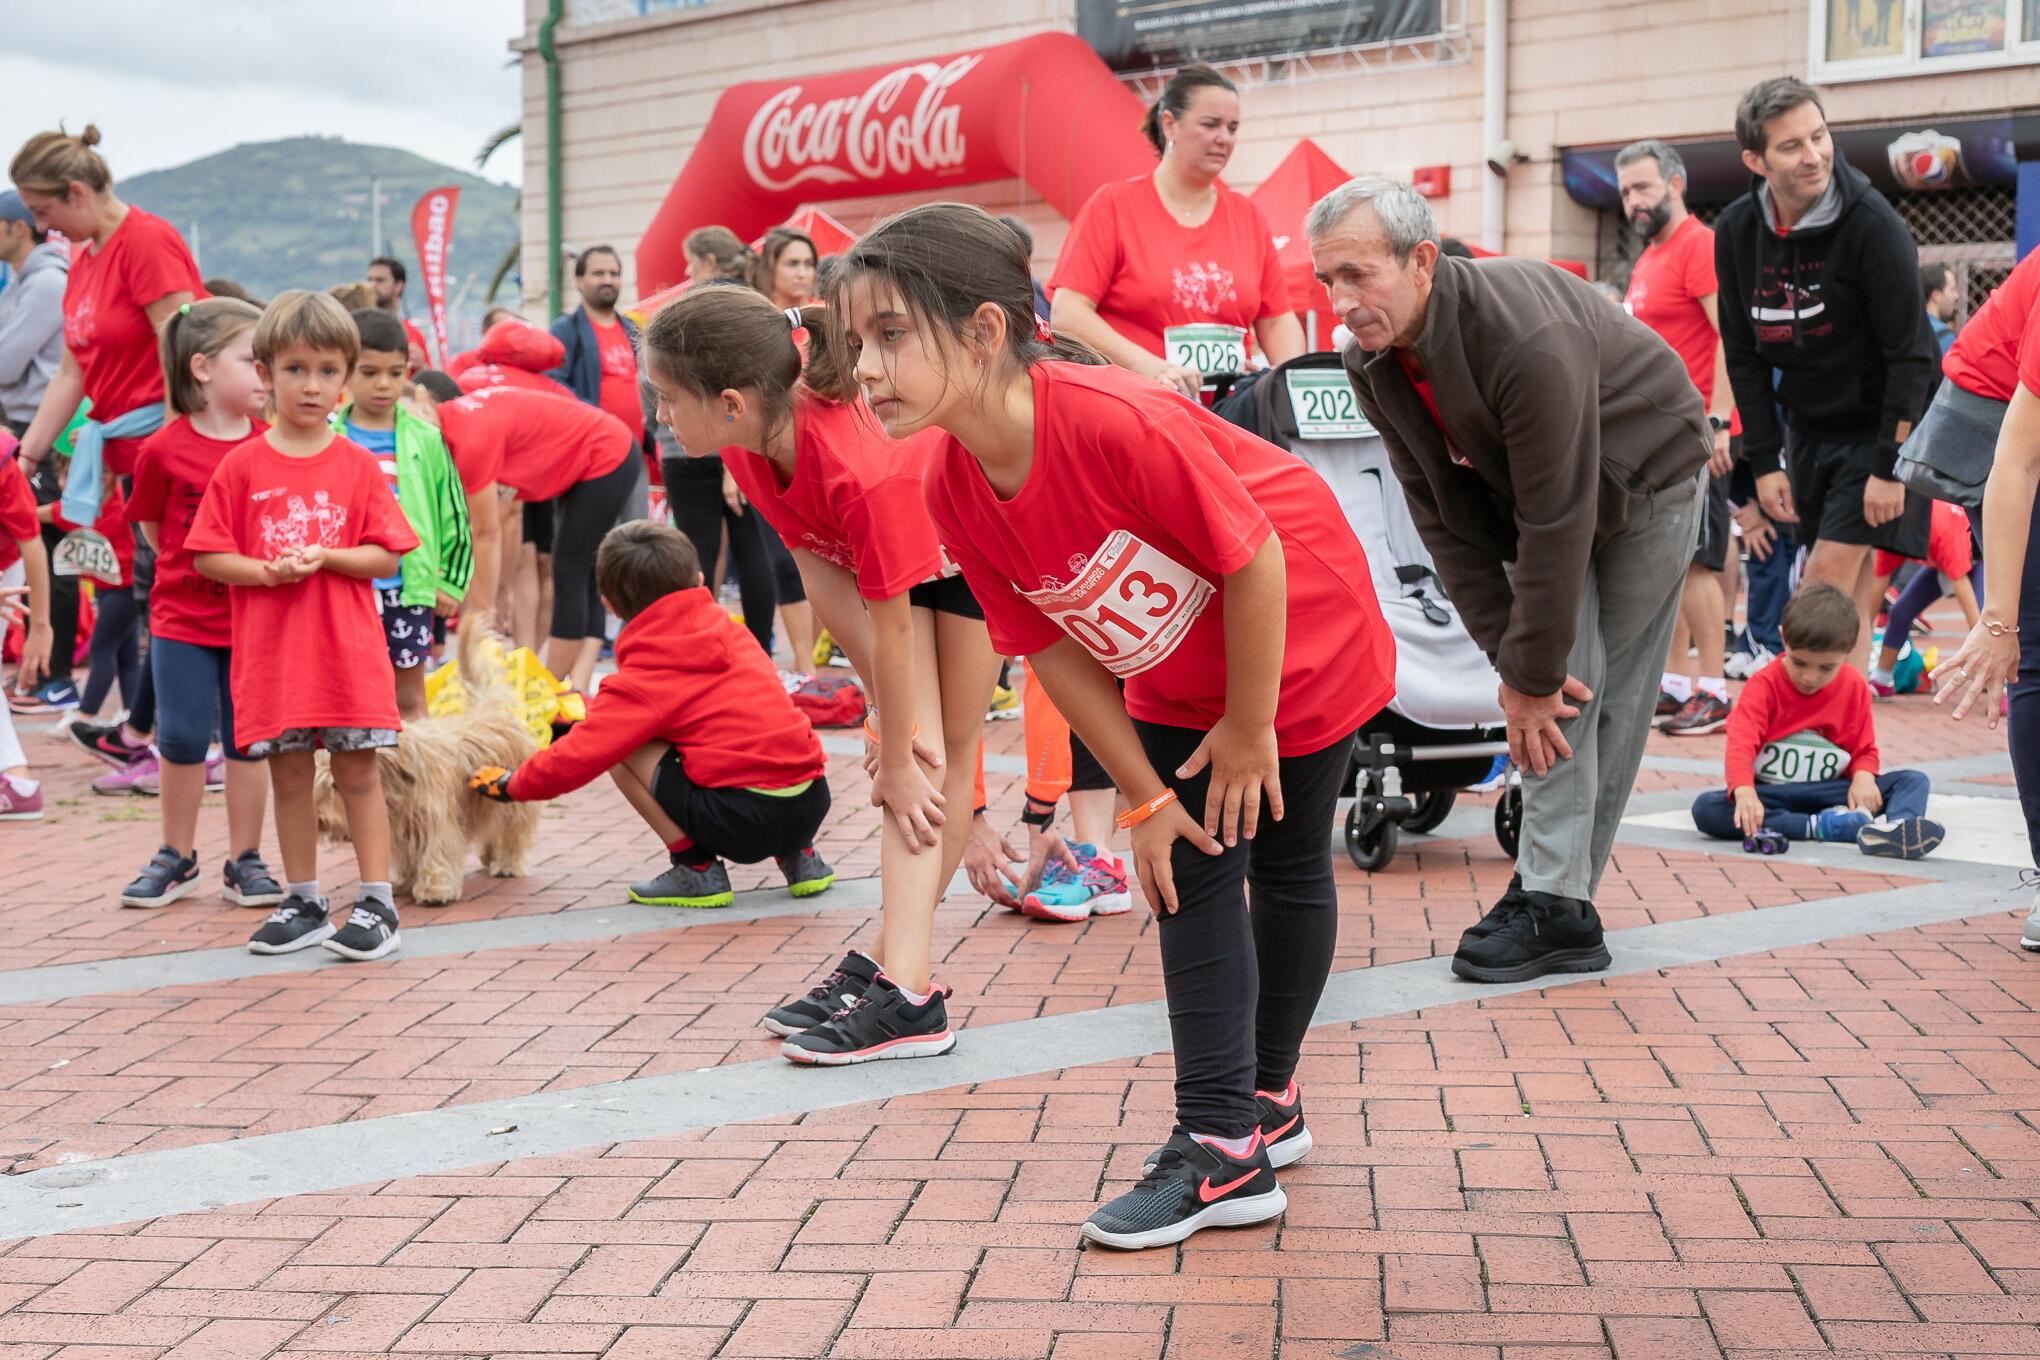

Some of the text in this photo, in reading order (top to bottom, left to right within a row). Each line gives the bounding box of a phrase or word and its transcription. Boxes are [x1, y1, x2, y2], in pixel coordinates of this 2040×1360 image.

[1178, 343, 1239, 373] 2026
[63, 541, 113, 574] 2049
[1062, 570, 1178, 657] 013
[1760, 744, 1839, 782] 2018
